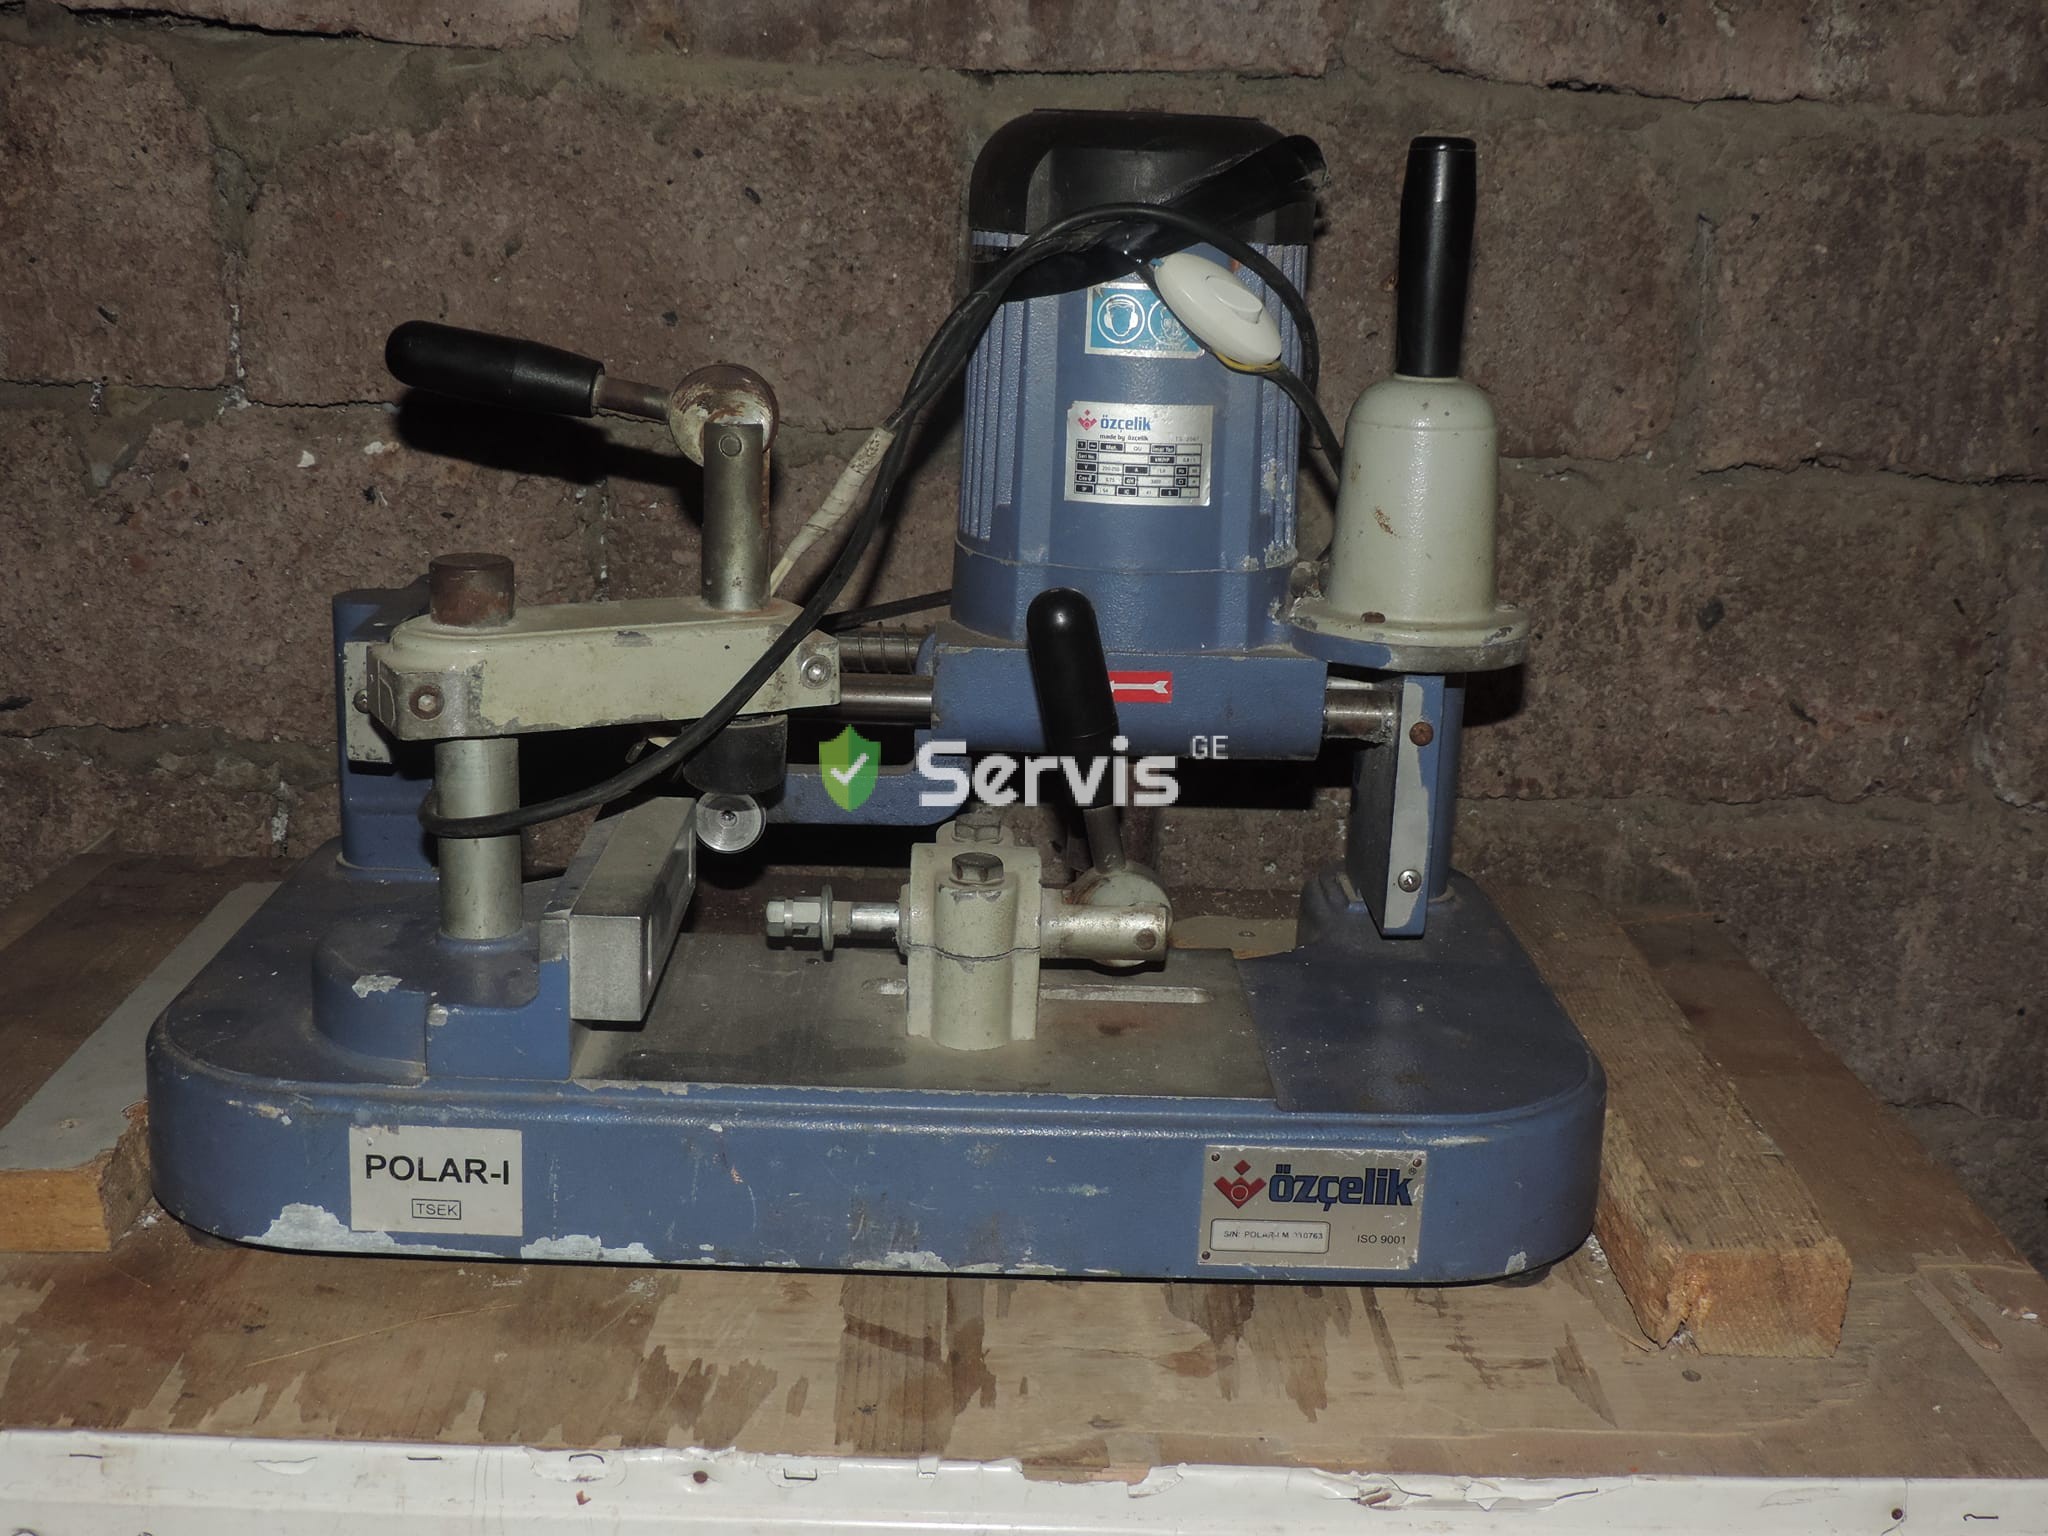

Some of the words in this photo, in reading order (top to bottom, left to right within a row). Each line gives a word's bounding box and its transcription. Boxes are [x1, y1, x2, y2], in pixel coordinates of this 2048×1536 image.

[1100, 414, 1151, 432] özçelik
[1099, 433, 1117, 441] made
[1117, 434, 1126, 442] by
[1127, 434, 1149, 442] özçelik
[365, 1154, 510, 1185] POLAR-I
[1268, 1163, 1413, 1212] özçelik
[416, 1203, 458, 1216] TSEK
[1357, 1234, 1378, 1244] ISO
[1380, 1234, 1407, 1245] 9001
